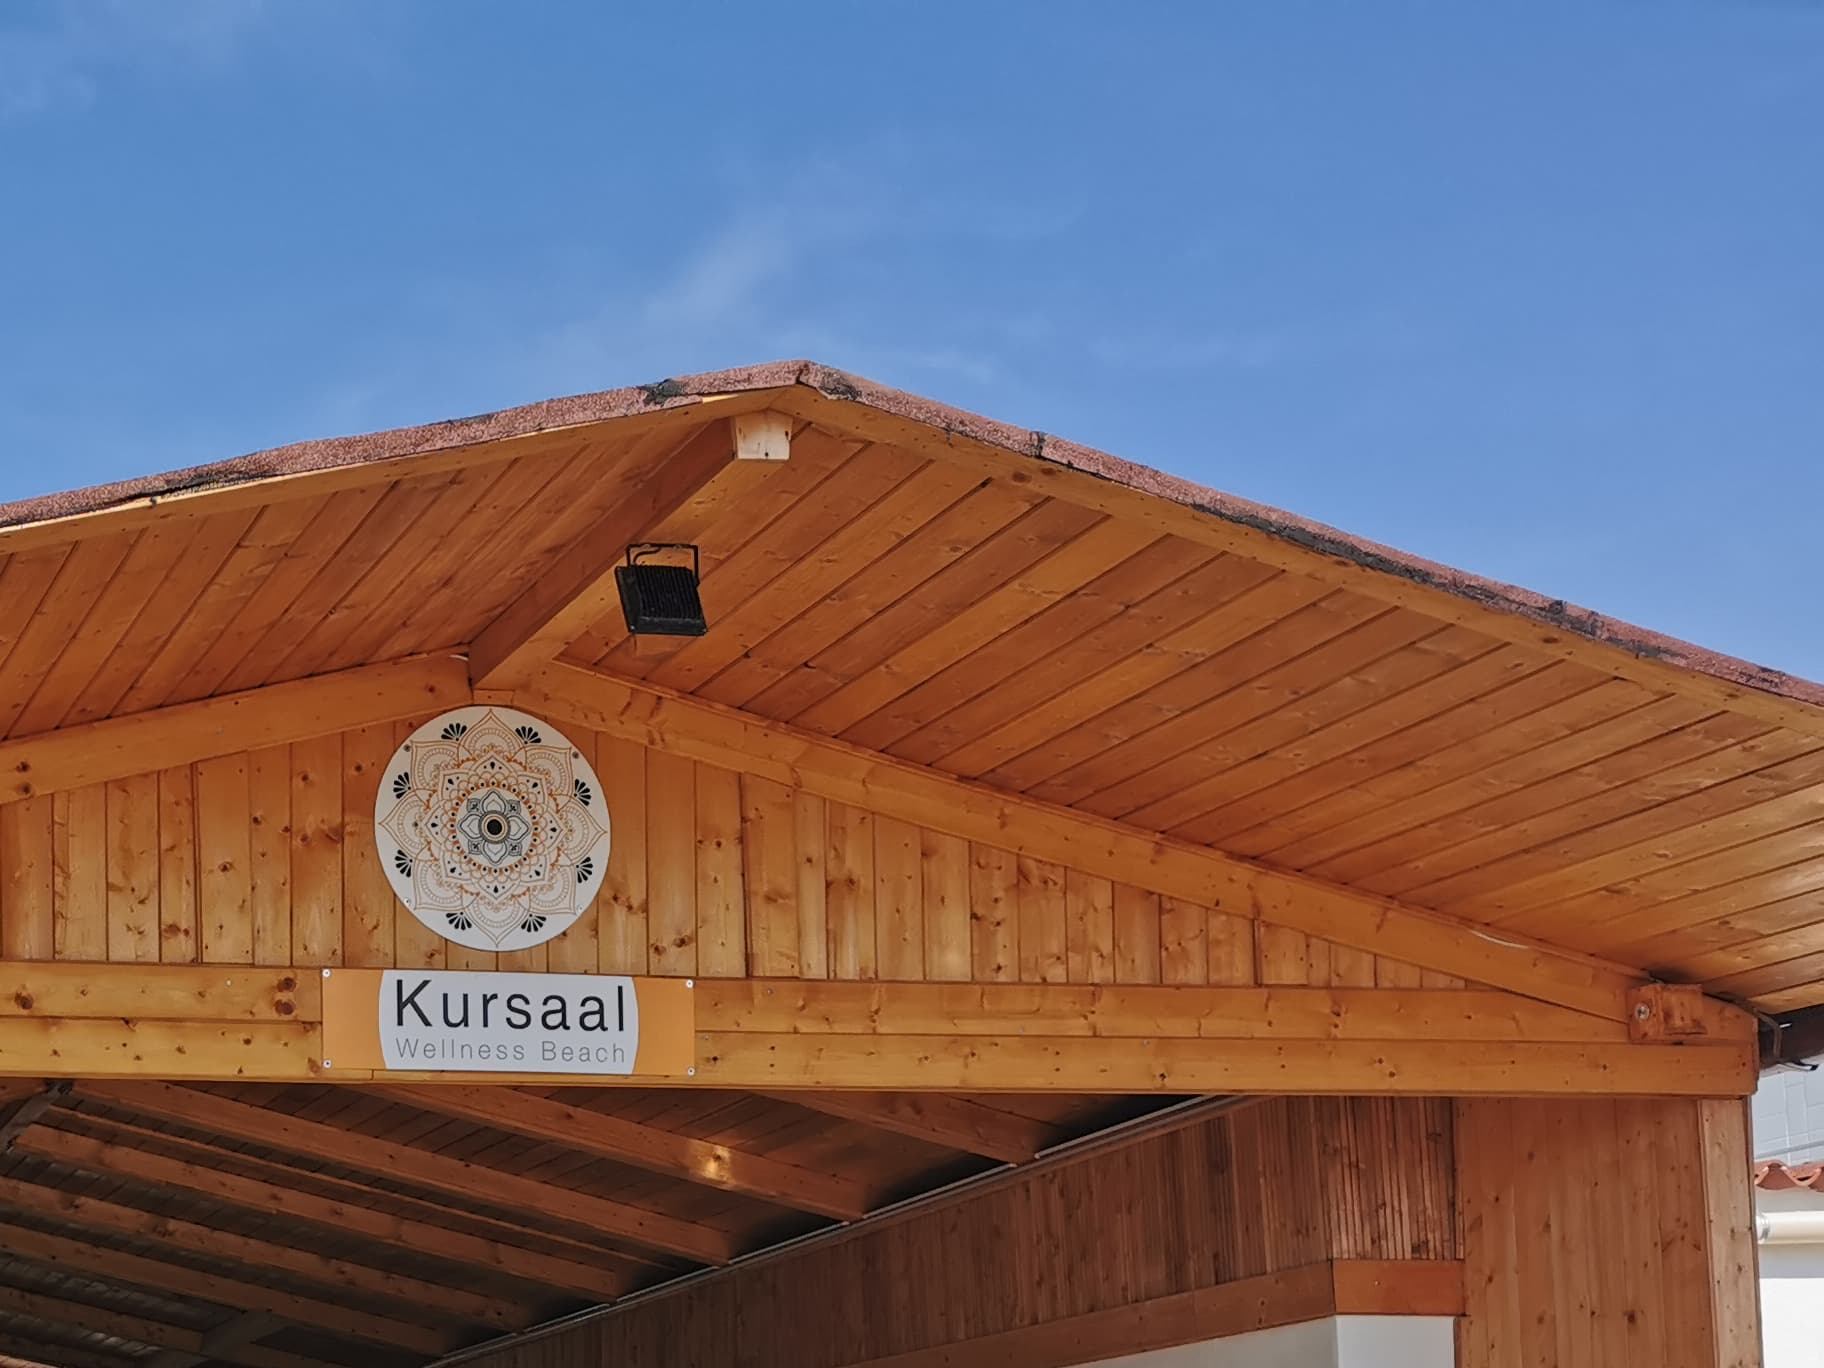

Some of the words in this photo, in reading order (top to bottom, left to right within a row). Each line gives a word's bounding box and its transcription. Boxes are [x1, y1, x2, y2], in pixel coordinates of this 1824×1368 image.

[396, 979, 625, 1032] Kursaal
[395, 1038, 525, 1060] Wellness
[541, 1041, 625, 1063] Beach
